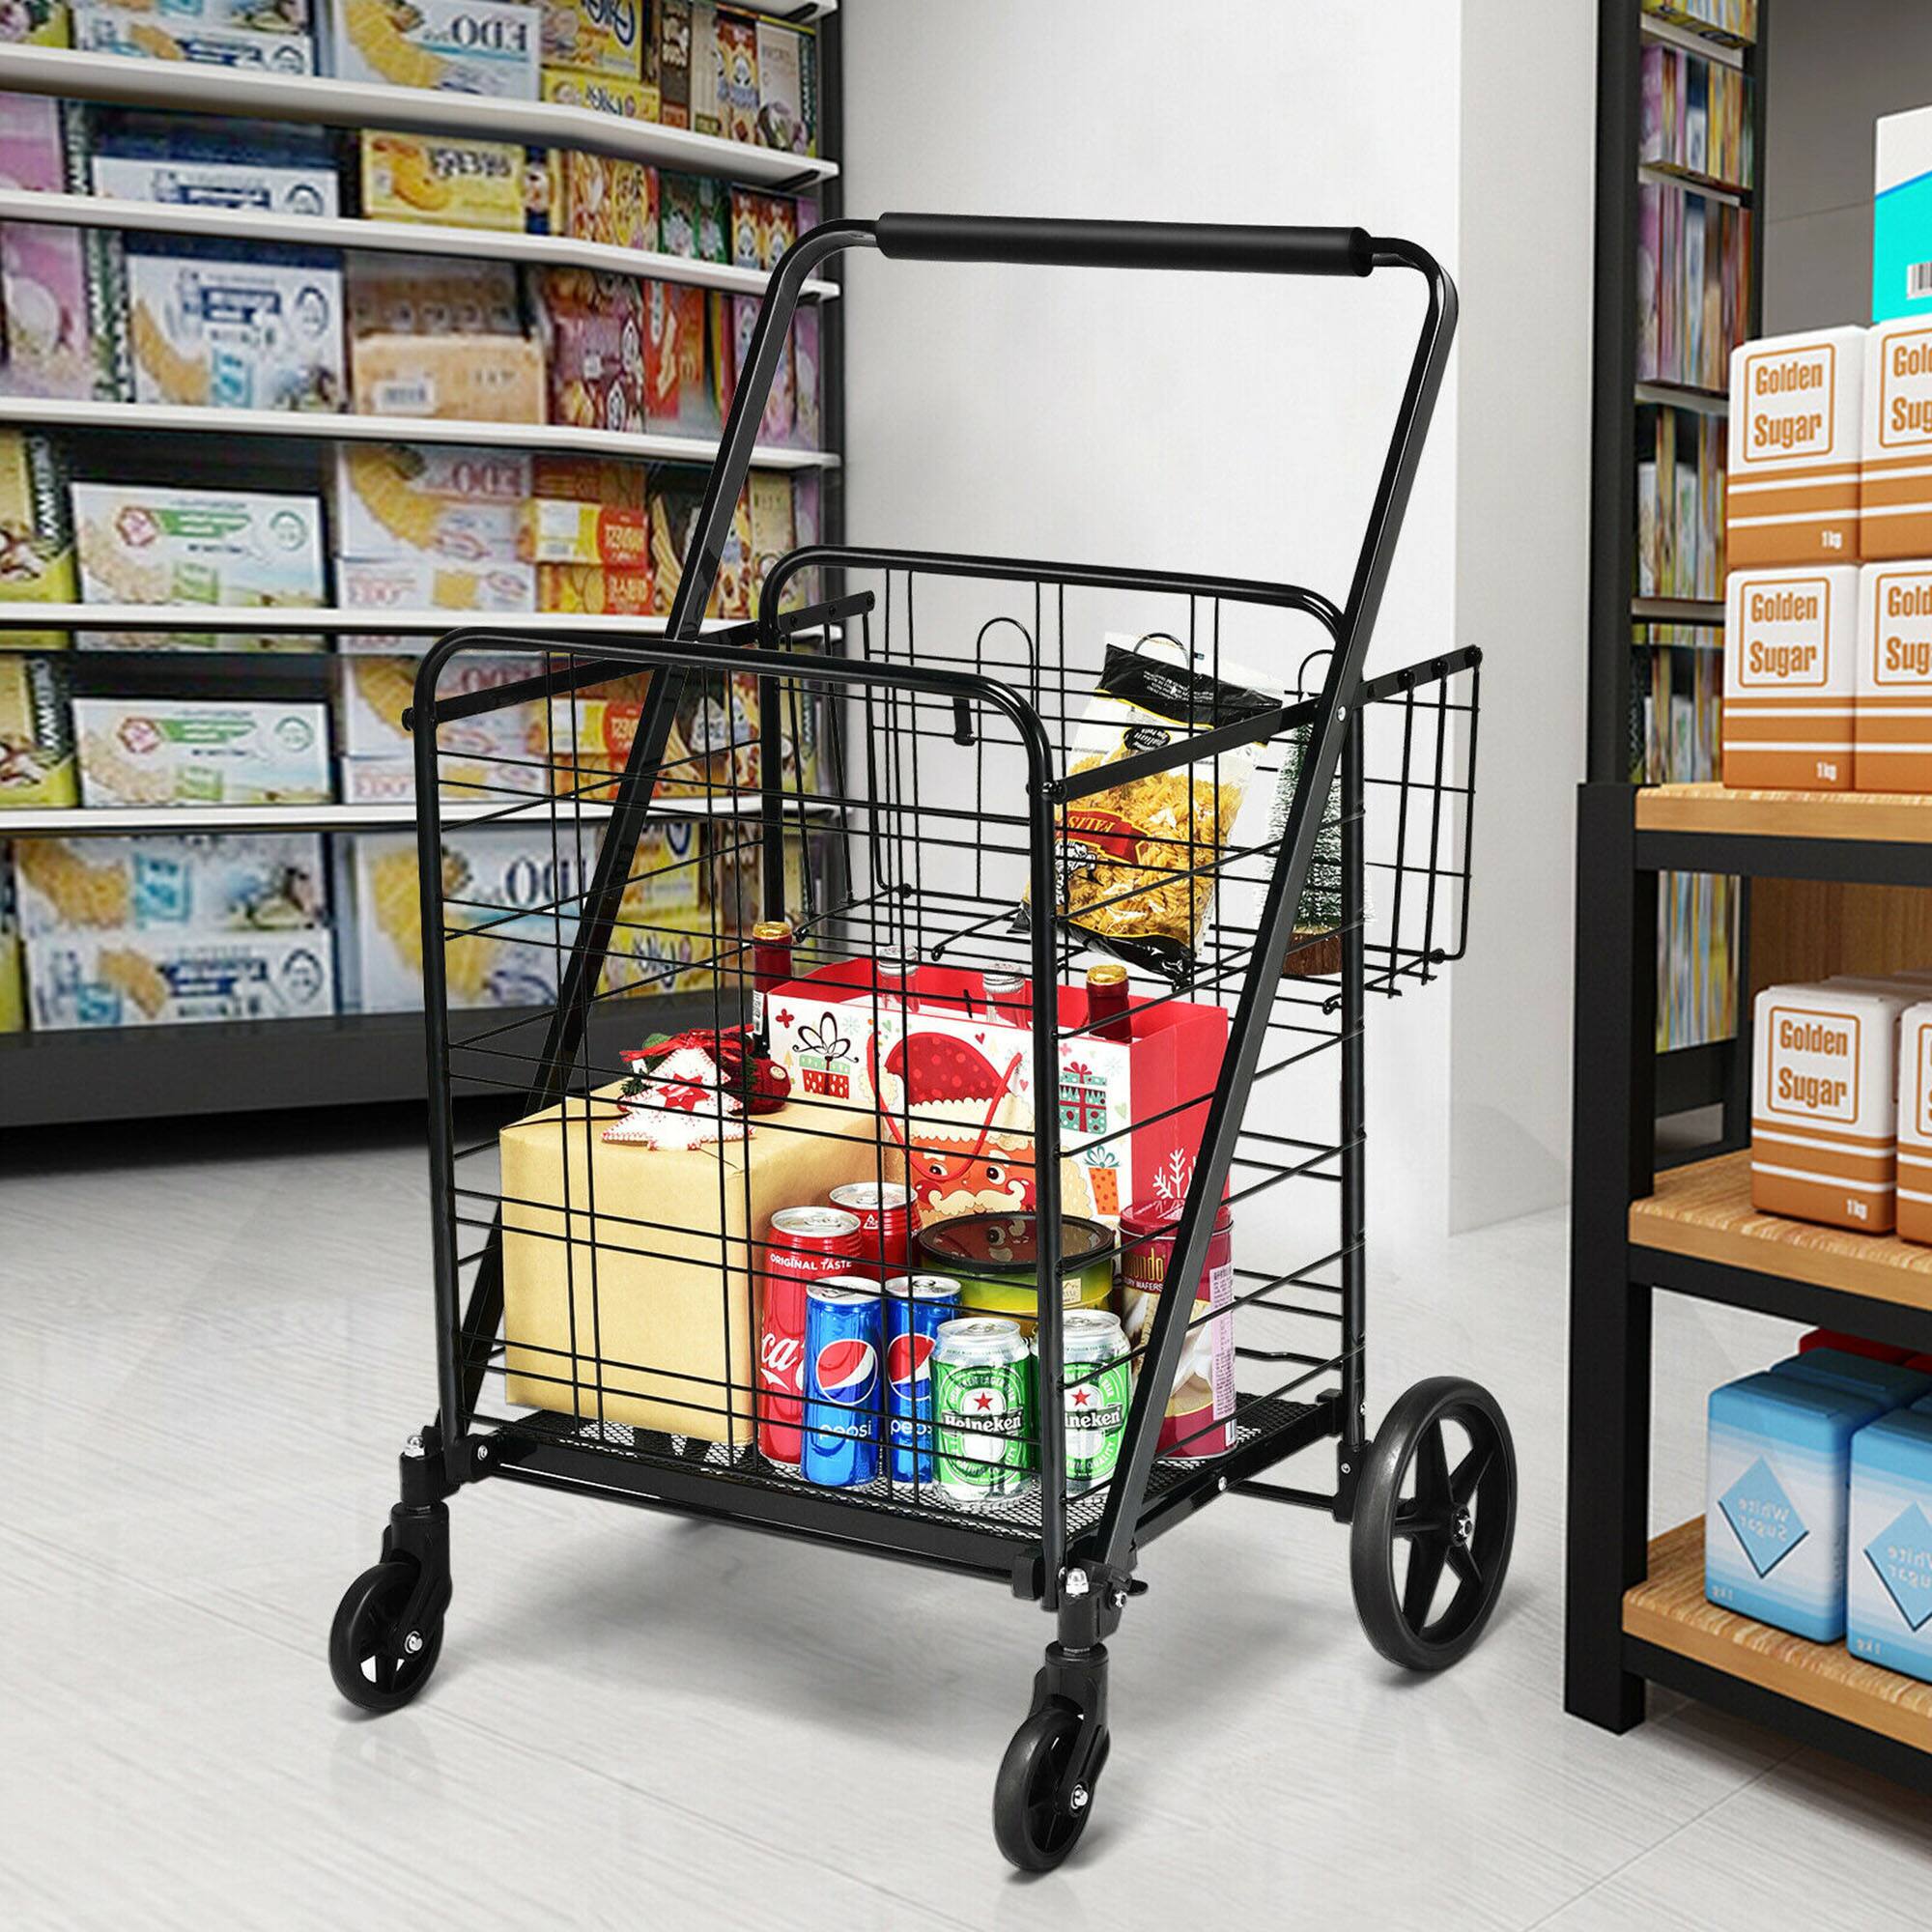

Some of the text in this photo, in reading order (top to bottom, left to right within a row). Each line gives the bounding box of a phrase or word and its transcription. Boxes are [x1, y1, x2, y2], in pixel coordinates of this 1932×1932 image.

[1755, 361, 1823, 396] Golden
[1892, 343, 1932, 379] Gol
[1754, 412, 1822, 449] Sugar
[1751, 591, 1818, 622] Golden
[1749, 639, 1817, 678] Sugar
[1779, 1020, 1848, 1058] Golden
[1778, 1066, 1847, 1109] Sugar
[770, 1253, 852, 1271] ORIGINAL TASTE
